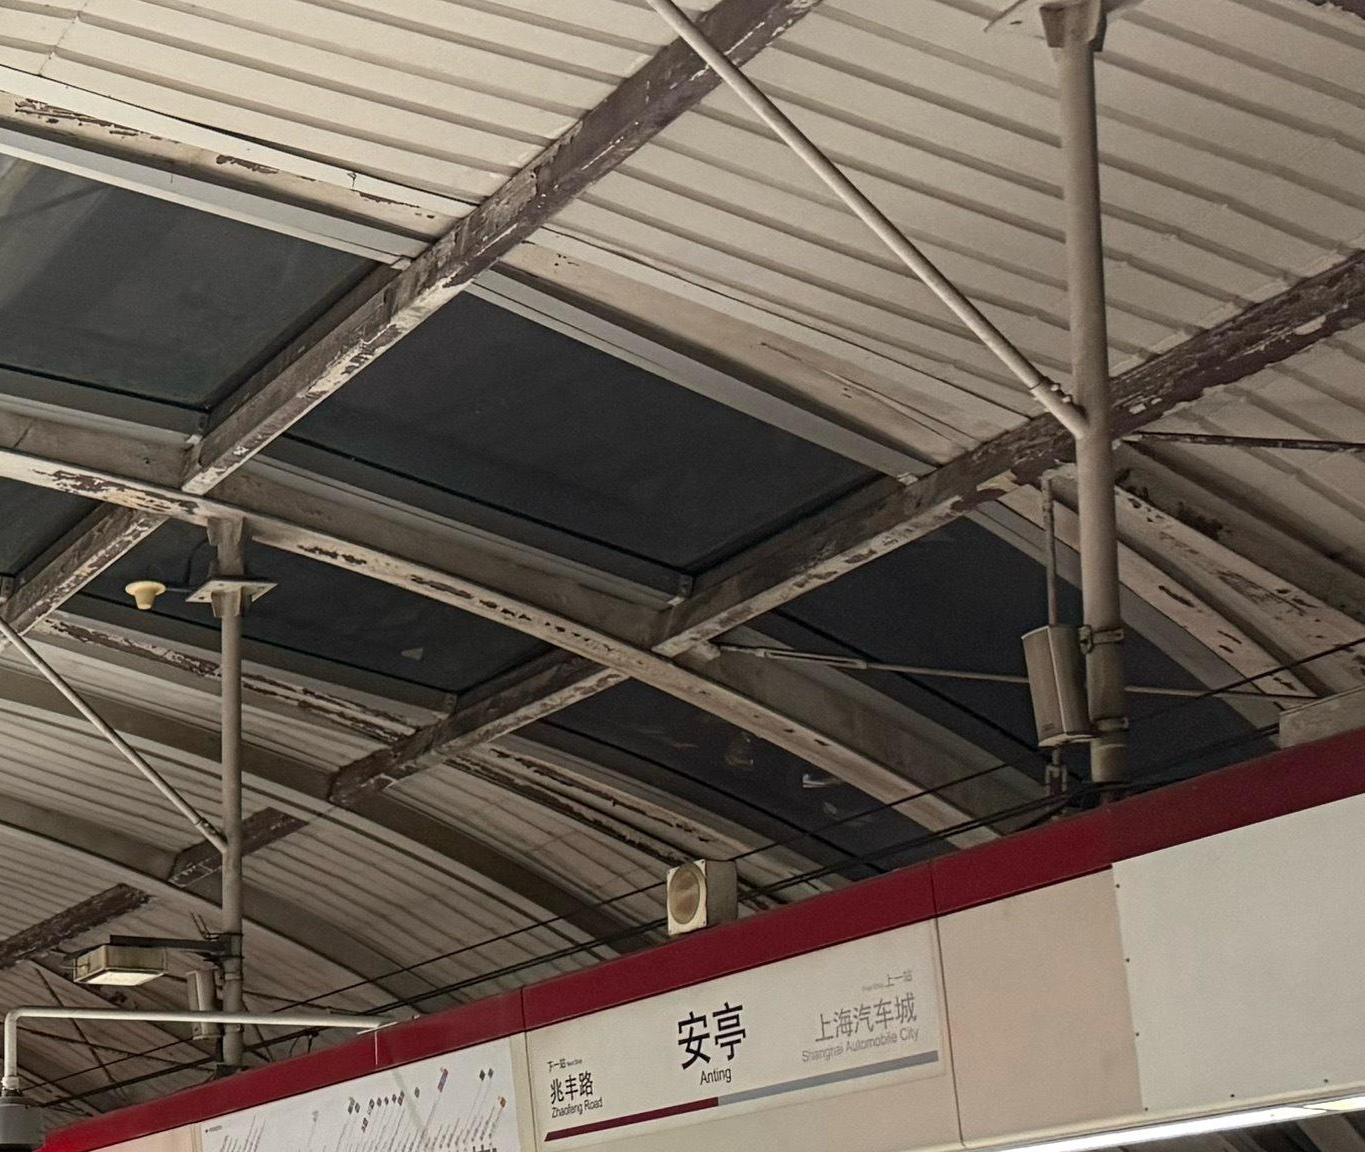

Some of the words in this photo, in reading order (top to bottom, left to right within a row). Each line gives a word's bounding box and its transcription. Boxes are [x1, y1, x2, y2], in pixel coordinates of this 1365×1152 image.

[815, 992, 918, 1042] 上海汽车城
[677, 1001, 747, 1070] 安亭
[899, 1027, 919, 1042] City
[550, 1070, 594, 1104] 兆丰路
[700, 1067, 732, 1085] Anting
[584, 1097, 603, 1111] Road
